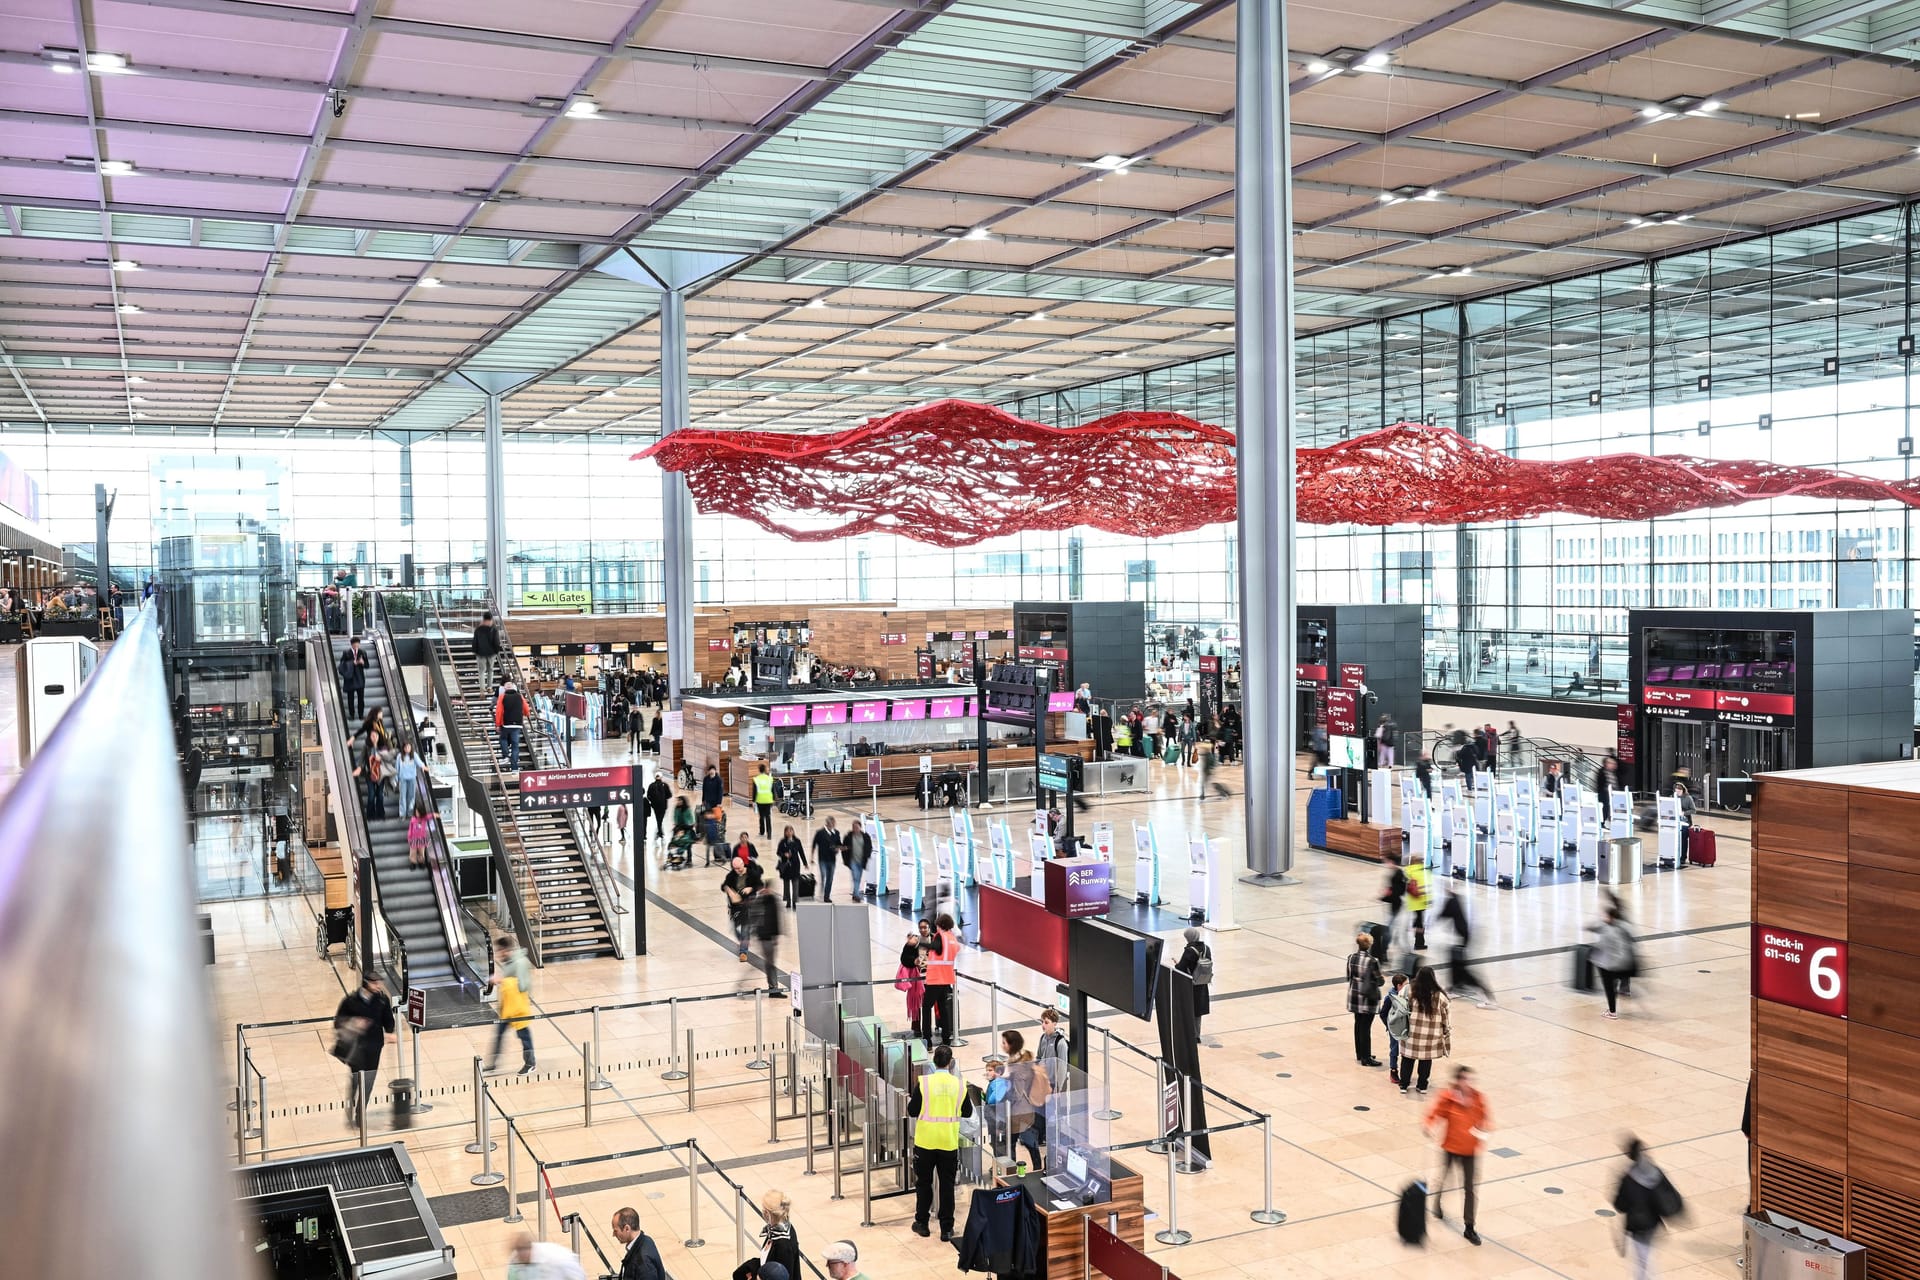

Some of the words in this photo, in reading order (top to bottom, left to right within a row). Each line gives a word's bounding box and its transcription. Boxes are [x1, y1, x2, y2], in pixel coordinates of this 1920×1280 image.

[542, 593, 556, 602] All
[560, 594, 586, 602] Gates
[1080, 878, 1107, 886] Runway
[1764, 934, 1804, 951] Check-in
[1810, 947, 1840, 1000] 6
[1804, 1260, 1820, 1271] BER
